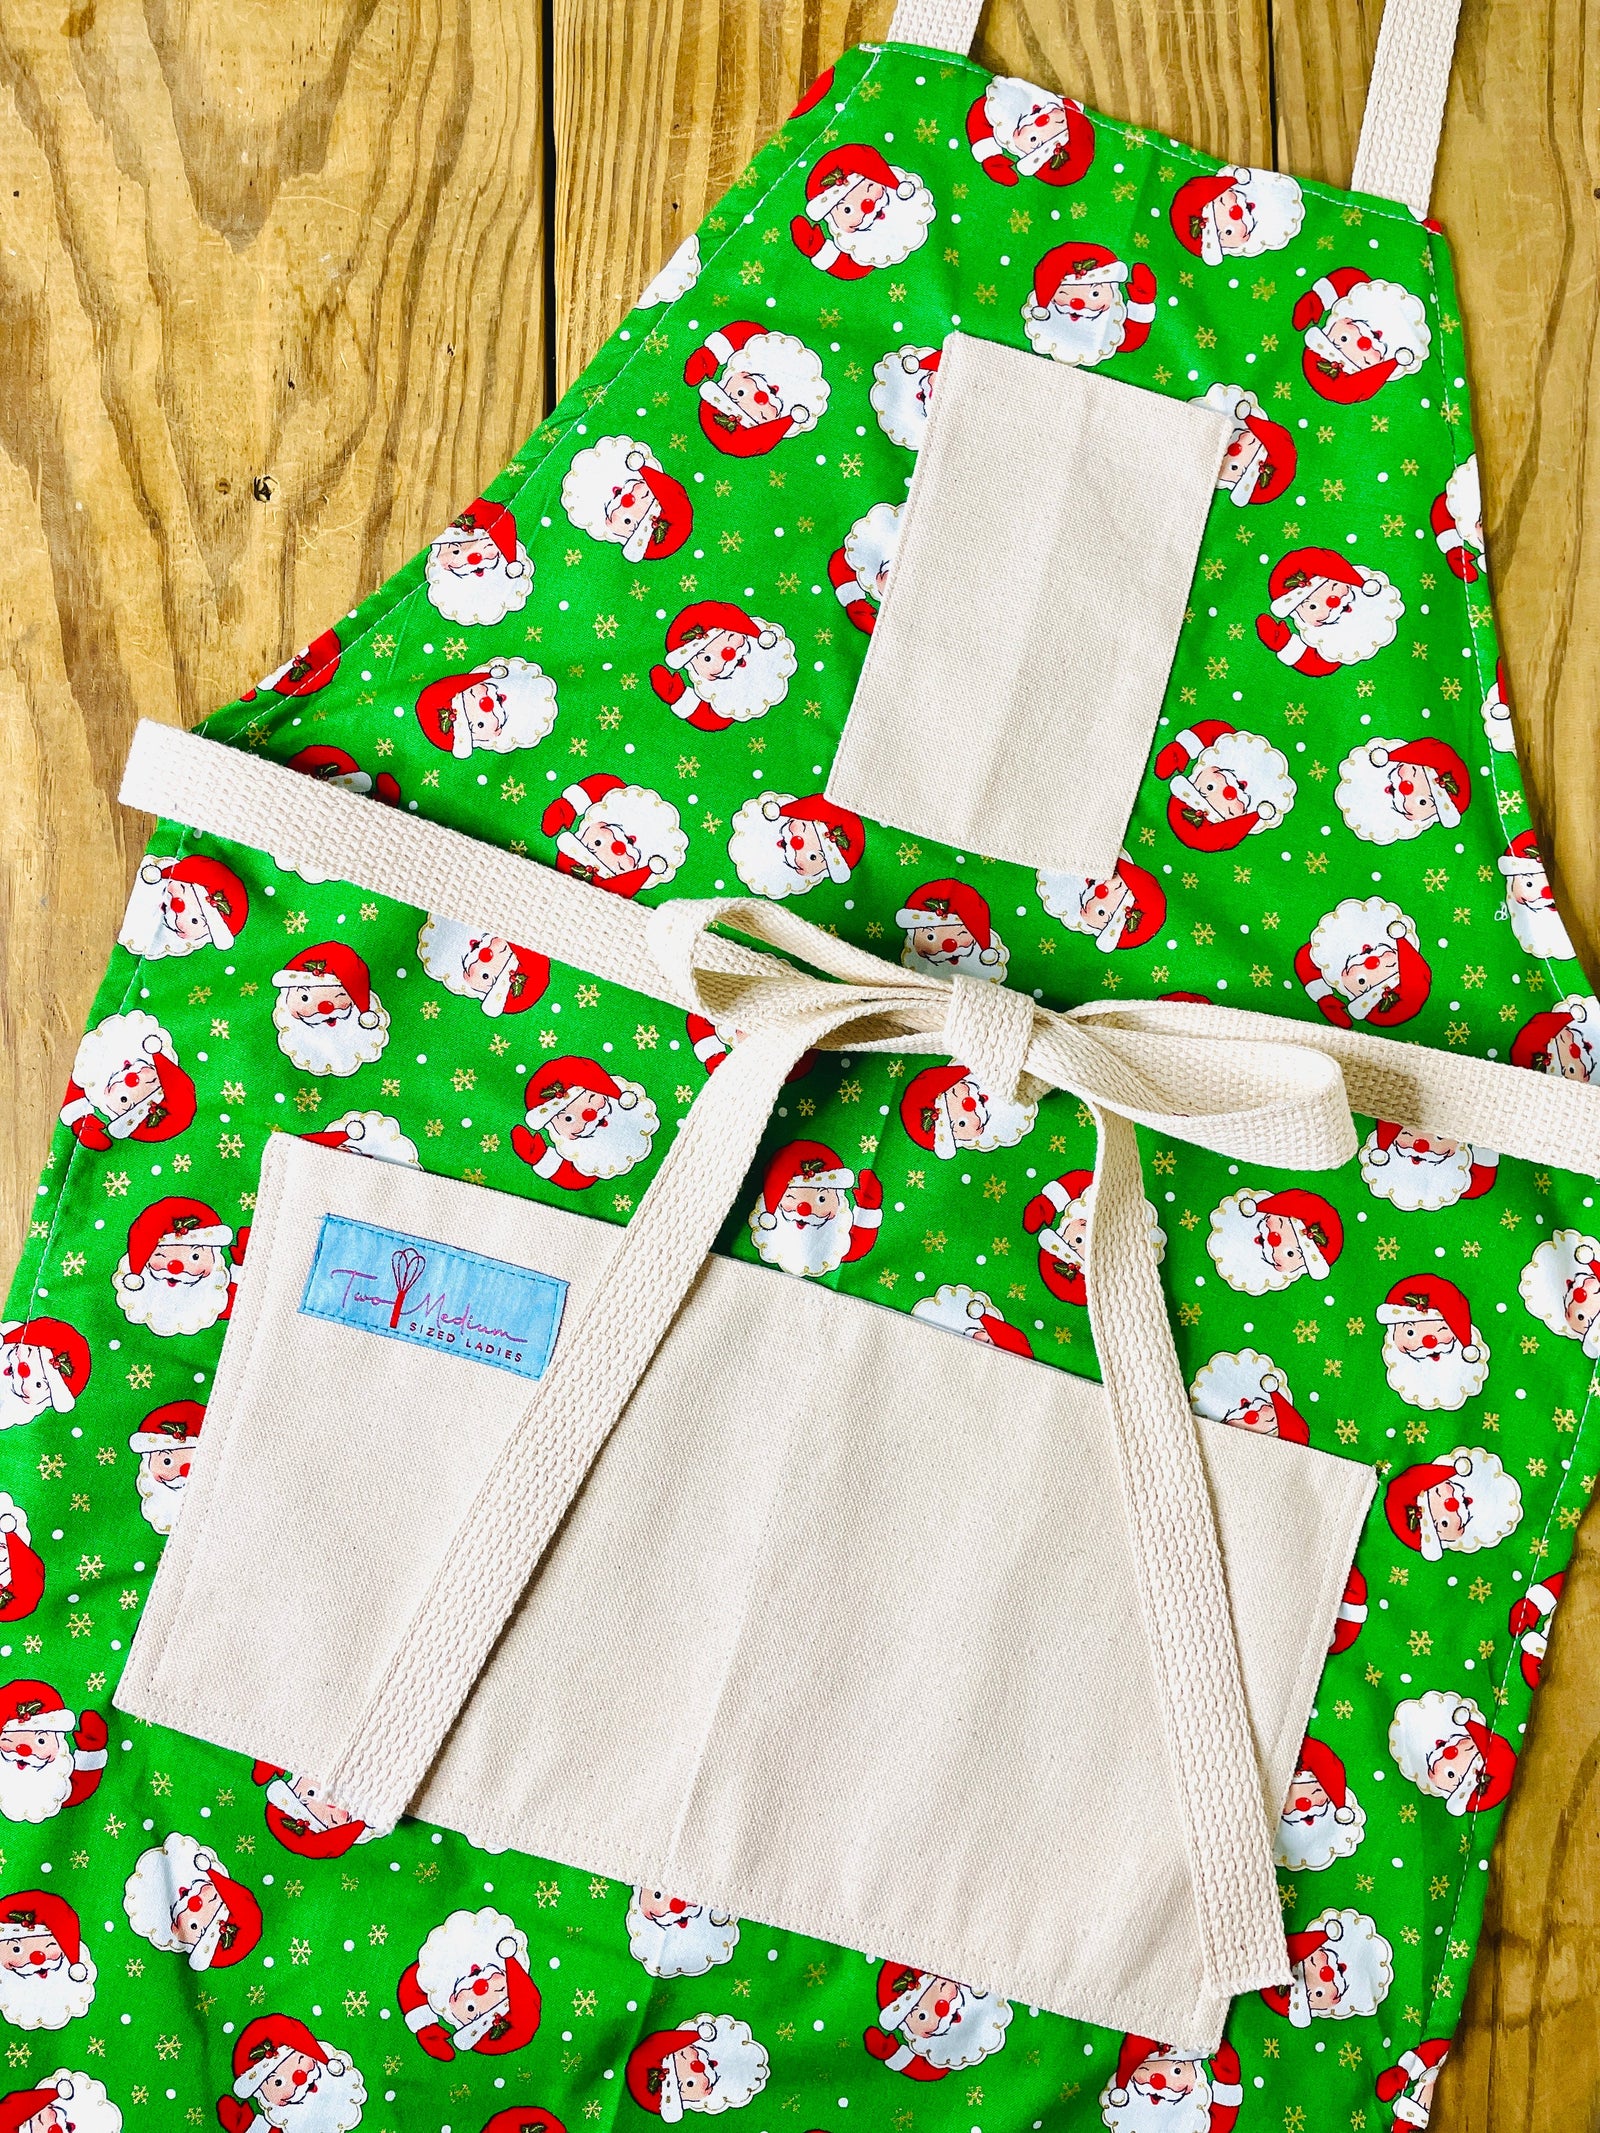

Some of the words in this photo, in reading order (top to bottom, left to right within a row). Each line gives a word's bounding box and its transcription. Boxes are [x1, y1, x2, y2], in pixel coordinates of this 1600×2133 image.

[331, 1269, 396, 1308] Two
[400, 1293, 528, 1343] Medium
[409, 1322, 455, 1343] SIZED
[465, 1337, 523, 1362] LADIES
